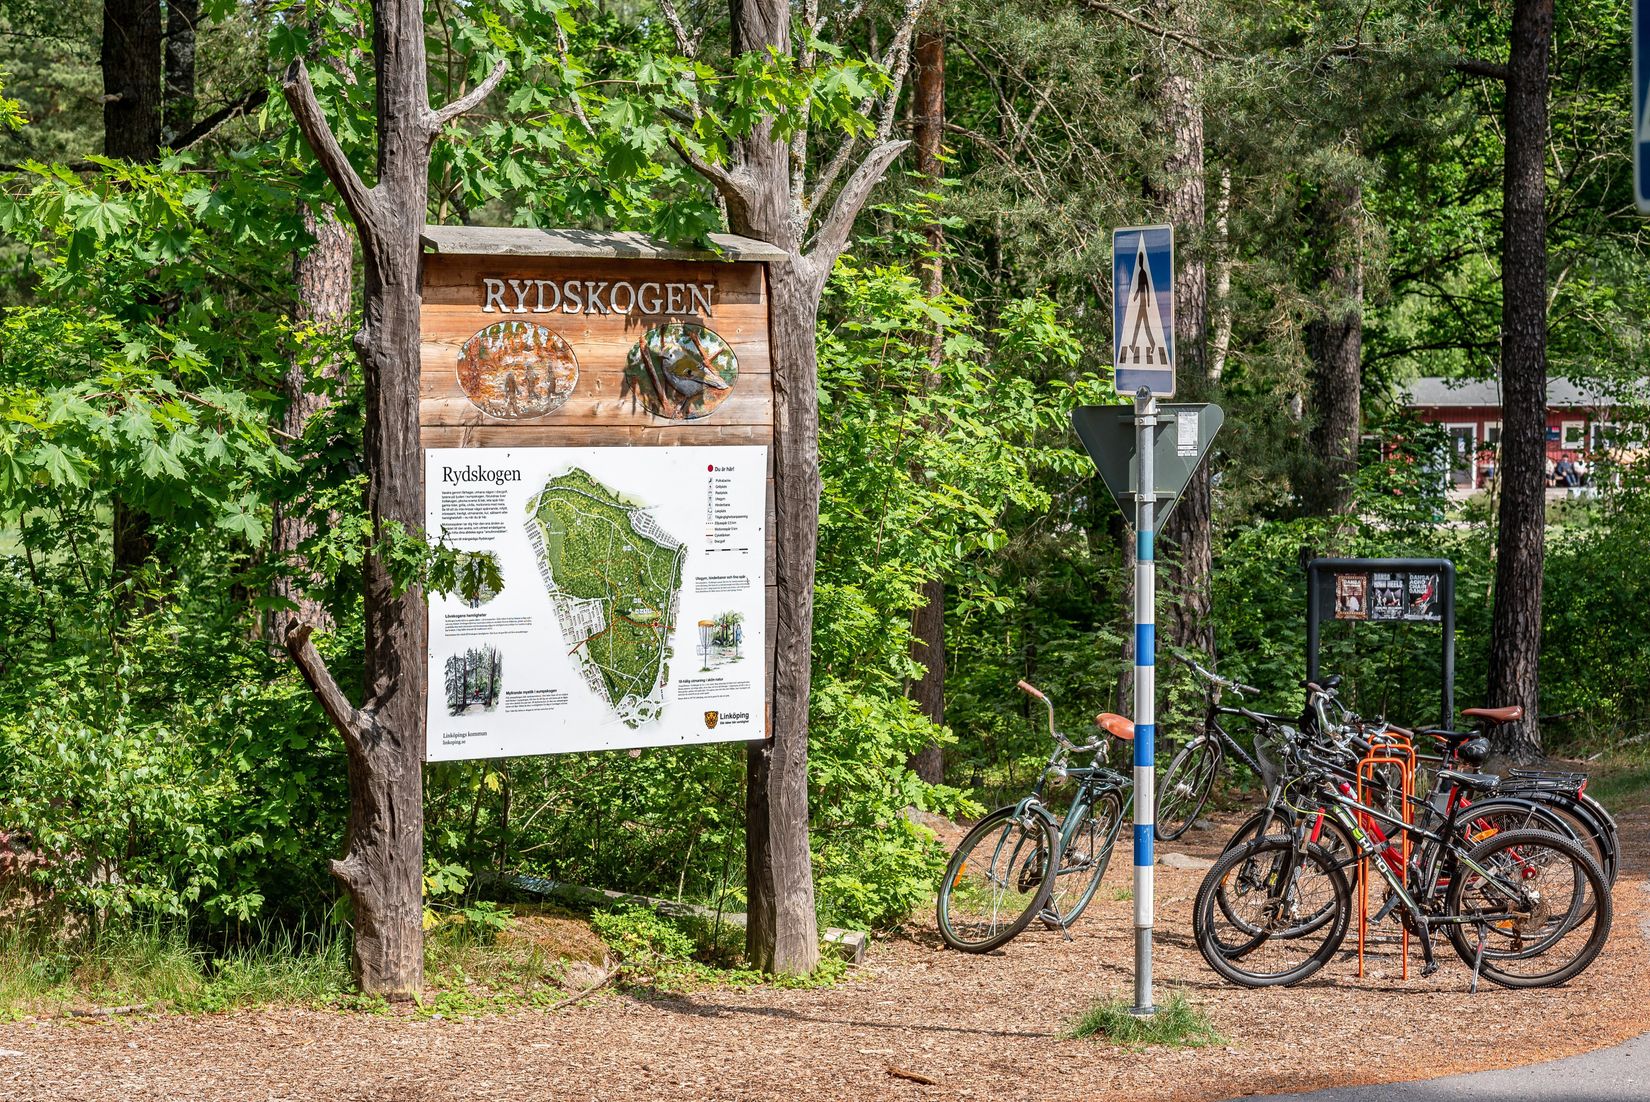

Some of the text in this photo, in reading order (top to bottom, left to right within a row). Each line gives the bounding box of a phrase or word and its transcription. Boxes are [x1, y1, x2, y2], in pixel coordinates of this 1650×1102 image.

[482, 278, 715, 316] RYDSKOGEN
[442, 465, 522, 486] Rydskogen
[720, 712, 749, 720] Linköping
